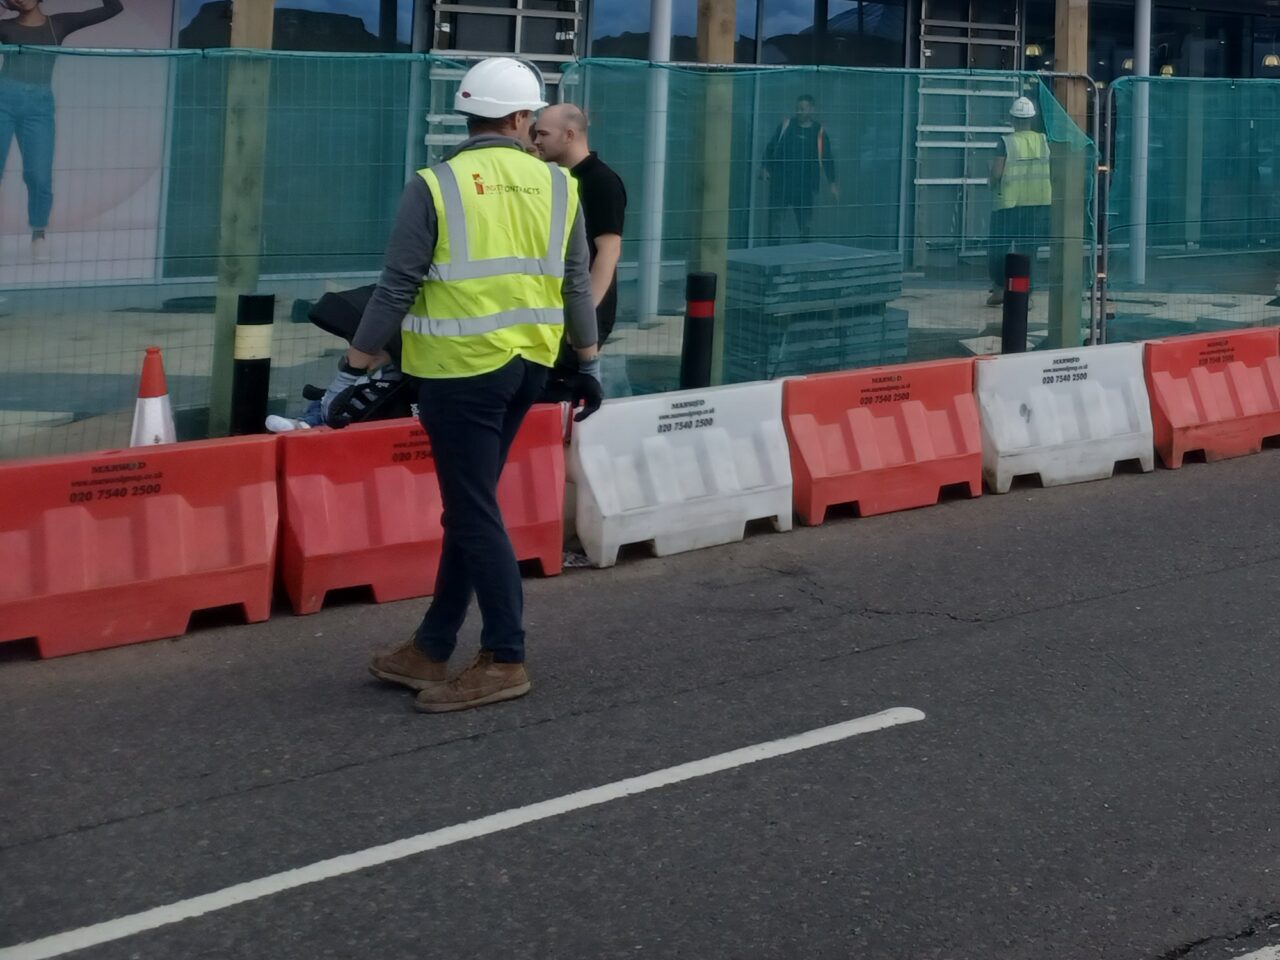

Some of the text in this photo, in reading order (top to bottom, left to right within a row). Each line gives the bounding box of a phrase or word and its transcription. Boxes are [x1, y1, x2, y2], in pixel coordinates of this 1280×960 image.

[1042, 372, 1088, 384] 020 7540 2500
[657, 417, 714, 433] 020 7540 2500
[69, 482, 161, 503] 020 7540 2500
